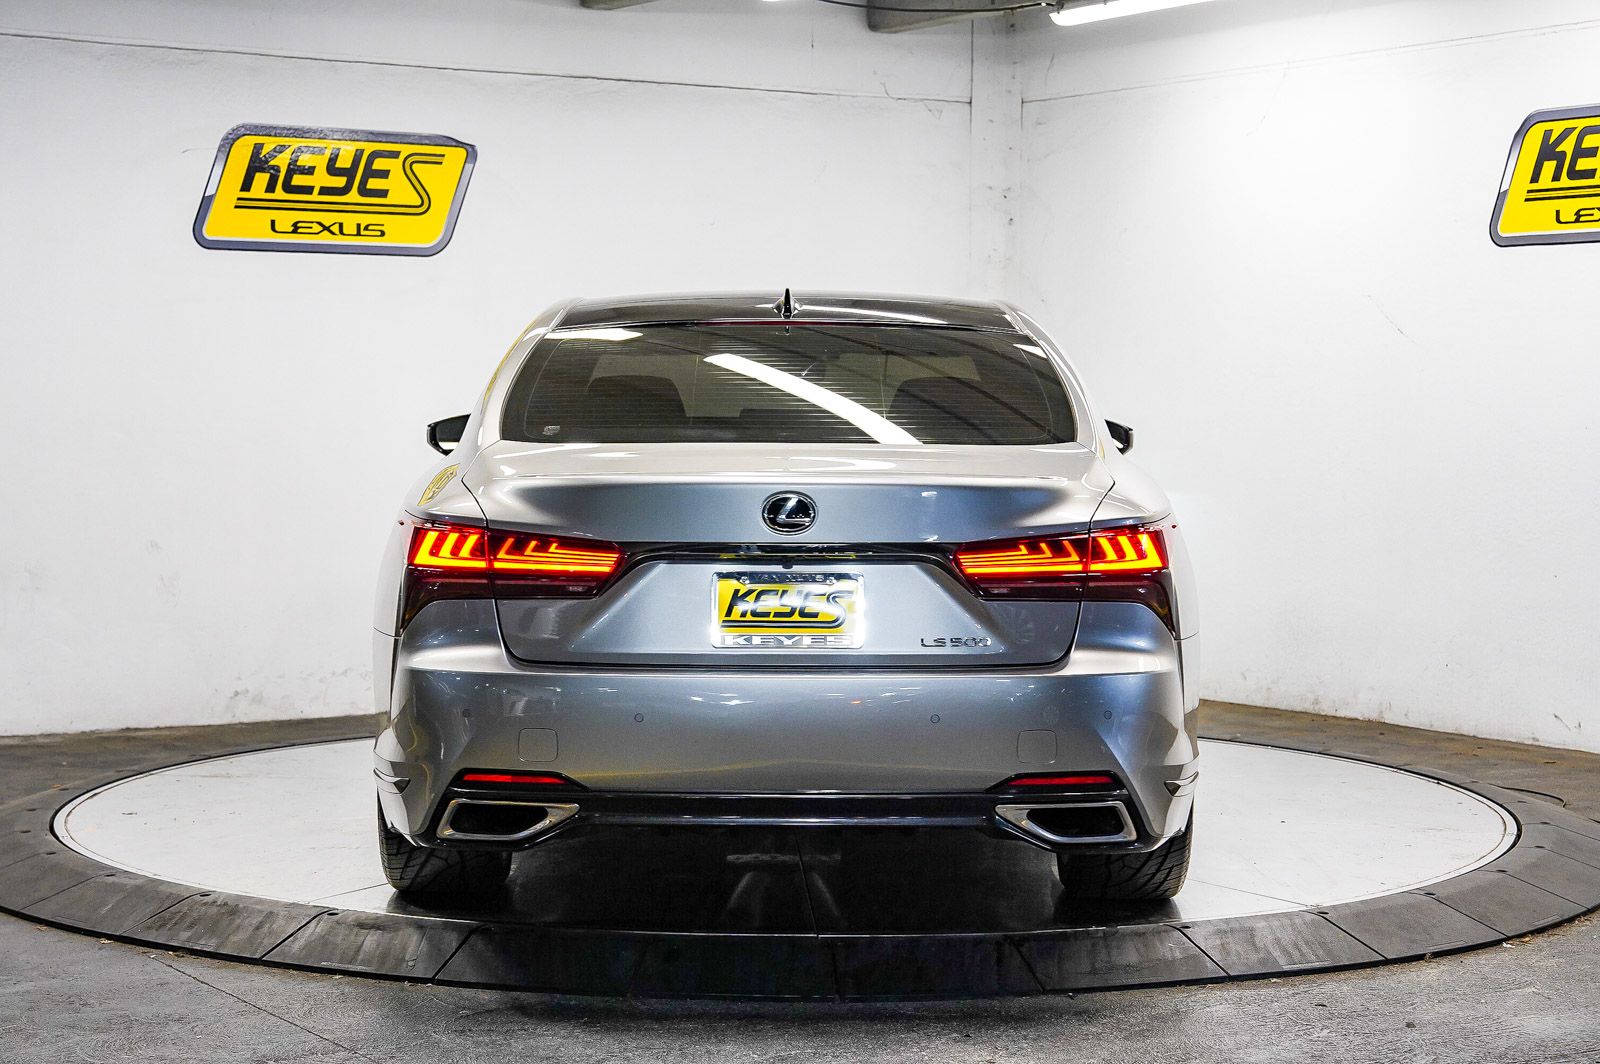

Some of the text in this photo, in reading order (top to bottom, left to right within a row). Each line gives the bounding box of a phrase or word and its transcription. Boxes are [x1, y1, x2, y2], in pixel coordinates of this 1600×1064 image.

[1529, 124, 1600, 184] KE
[238, 142, 446, 216] KEYES
[270, 219, 386, 238] LEXUS
[723, 588, 855, 628] KEYES
[724, 635, 852, 646] KEYES
[920, 637, 992, 648] LS 500
